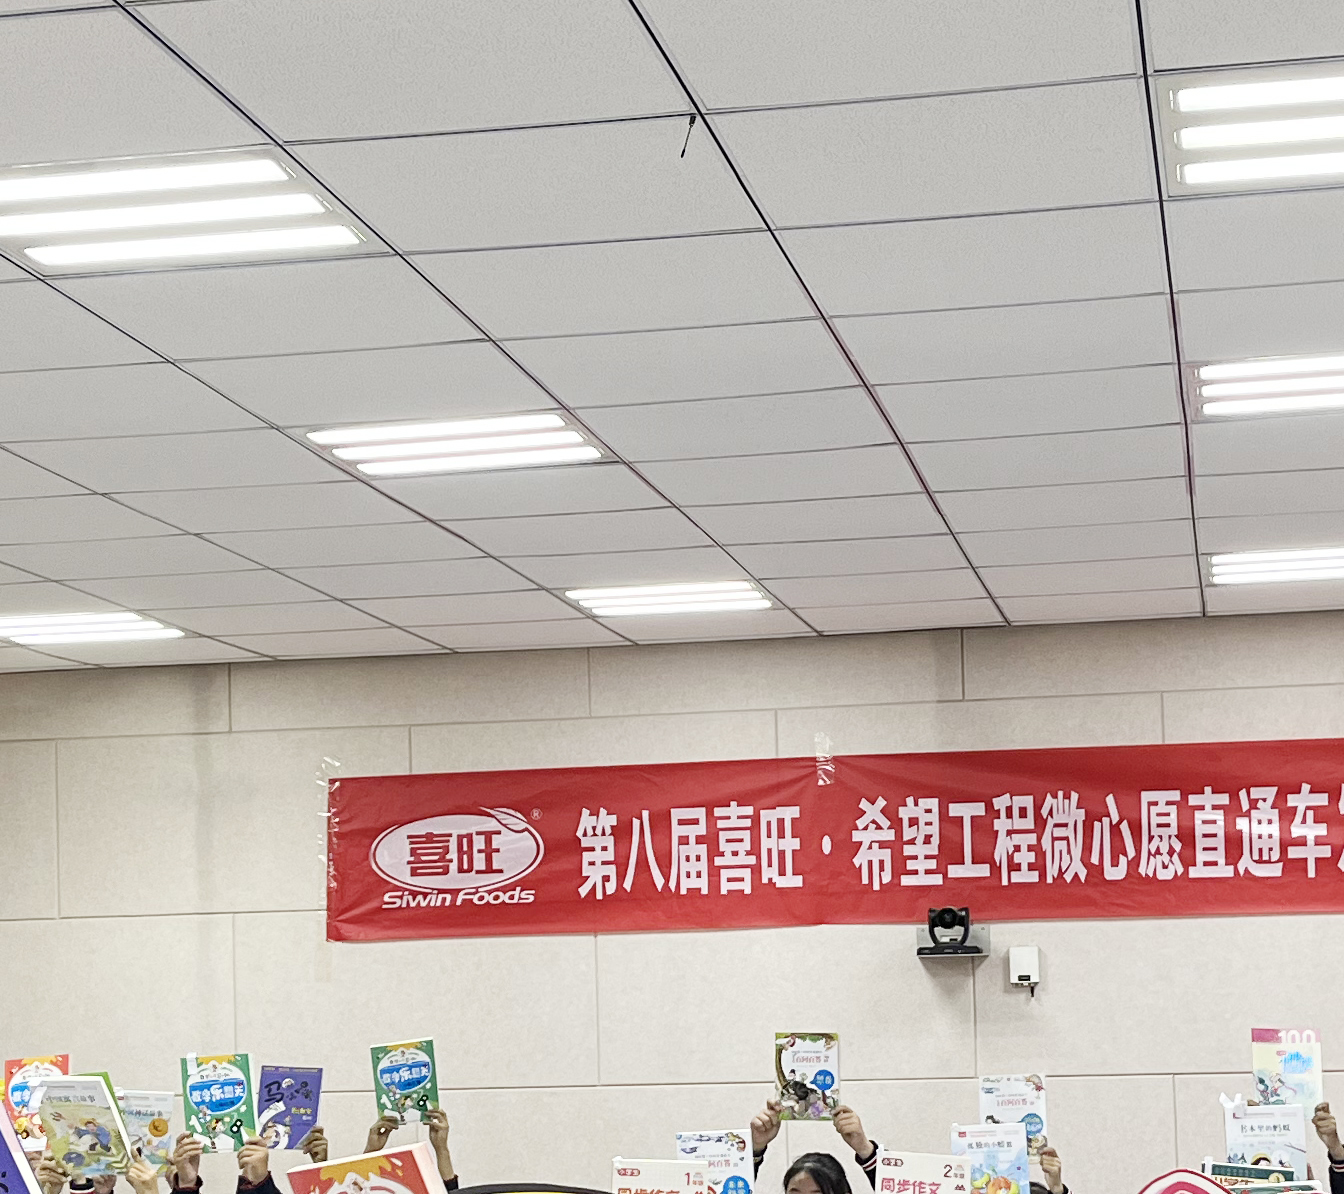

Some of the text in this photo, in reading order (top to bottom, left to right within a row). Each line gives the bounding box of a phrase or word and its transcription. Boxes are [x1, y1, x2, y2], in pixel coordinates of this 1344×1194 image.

[407, 830, 504, 877] 喜旺
[382, 886, 536, 909] Siwin Foods
